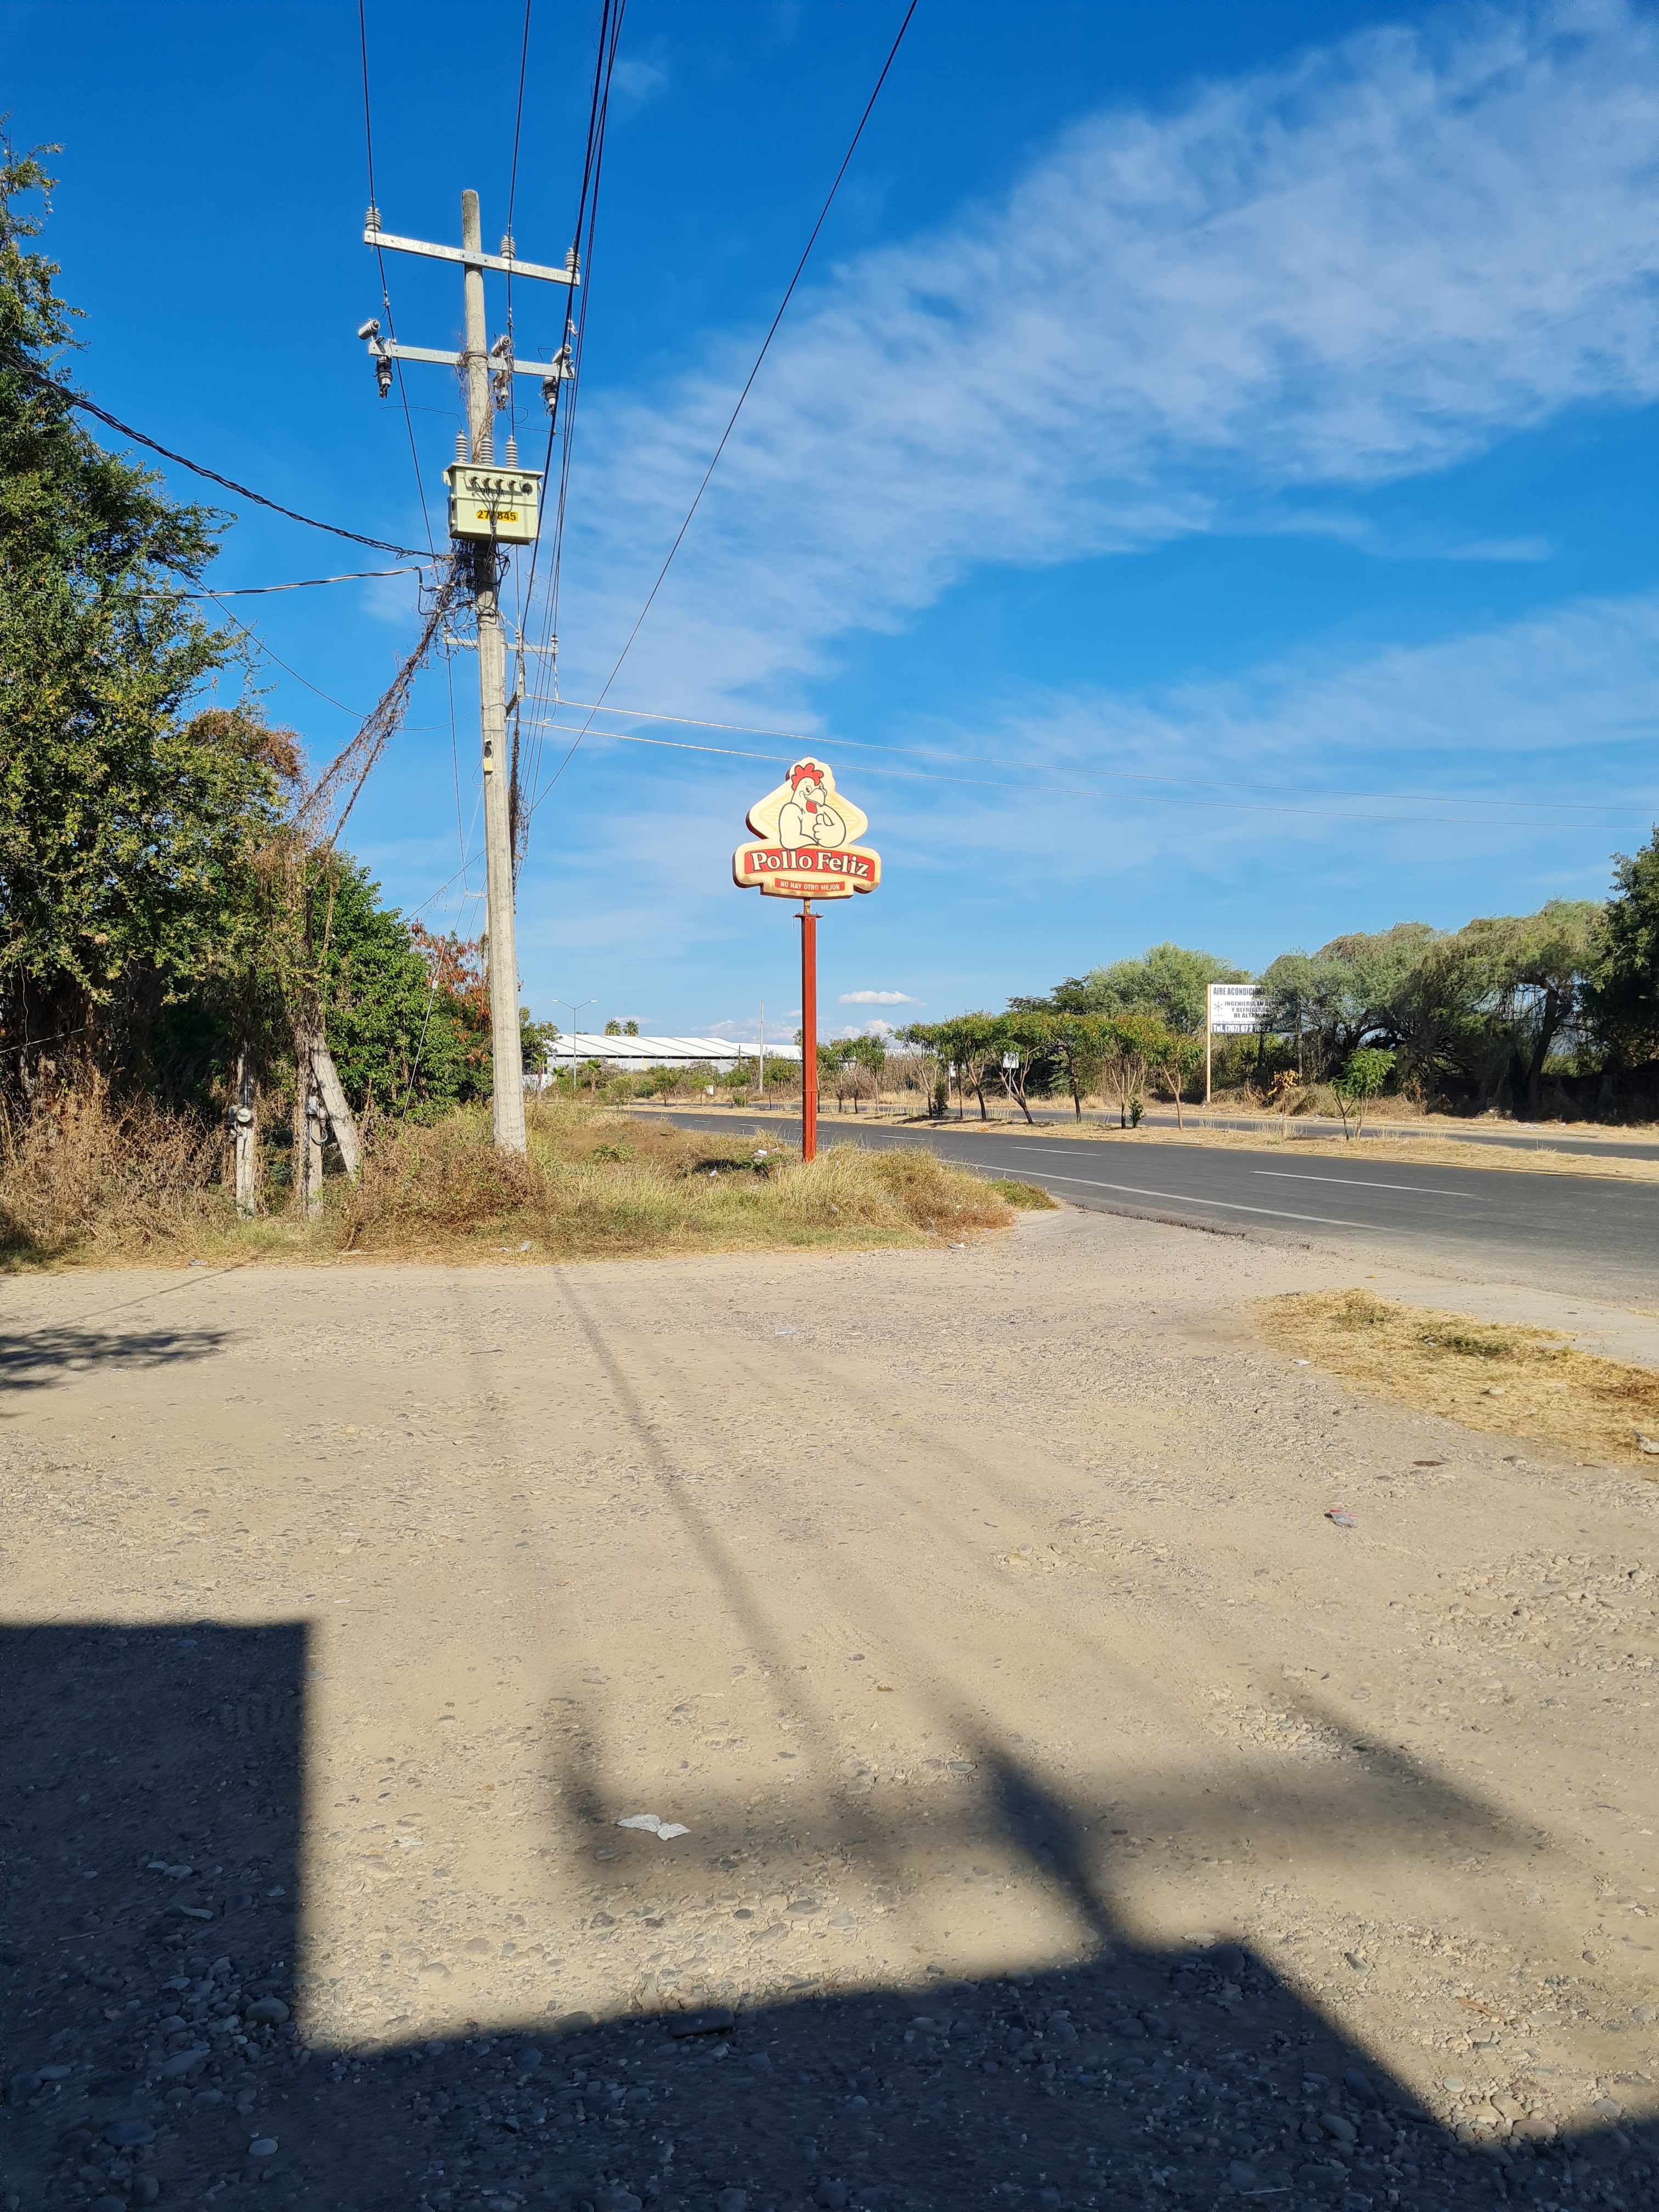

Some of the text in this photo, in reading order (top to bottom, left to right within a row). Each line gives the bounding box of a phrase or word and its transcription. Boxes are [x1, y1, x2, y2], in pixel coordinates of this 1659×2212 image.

[477, 510, 516, 521] 27845
[751, 849, 870, 877] Pollo Feliz
[790, 882, 802, 890] HAY
[1214, 987, 1226, 995] AIRE
[1225, 1024, 1240, 1032] (767)
